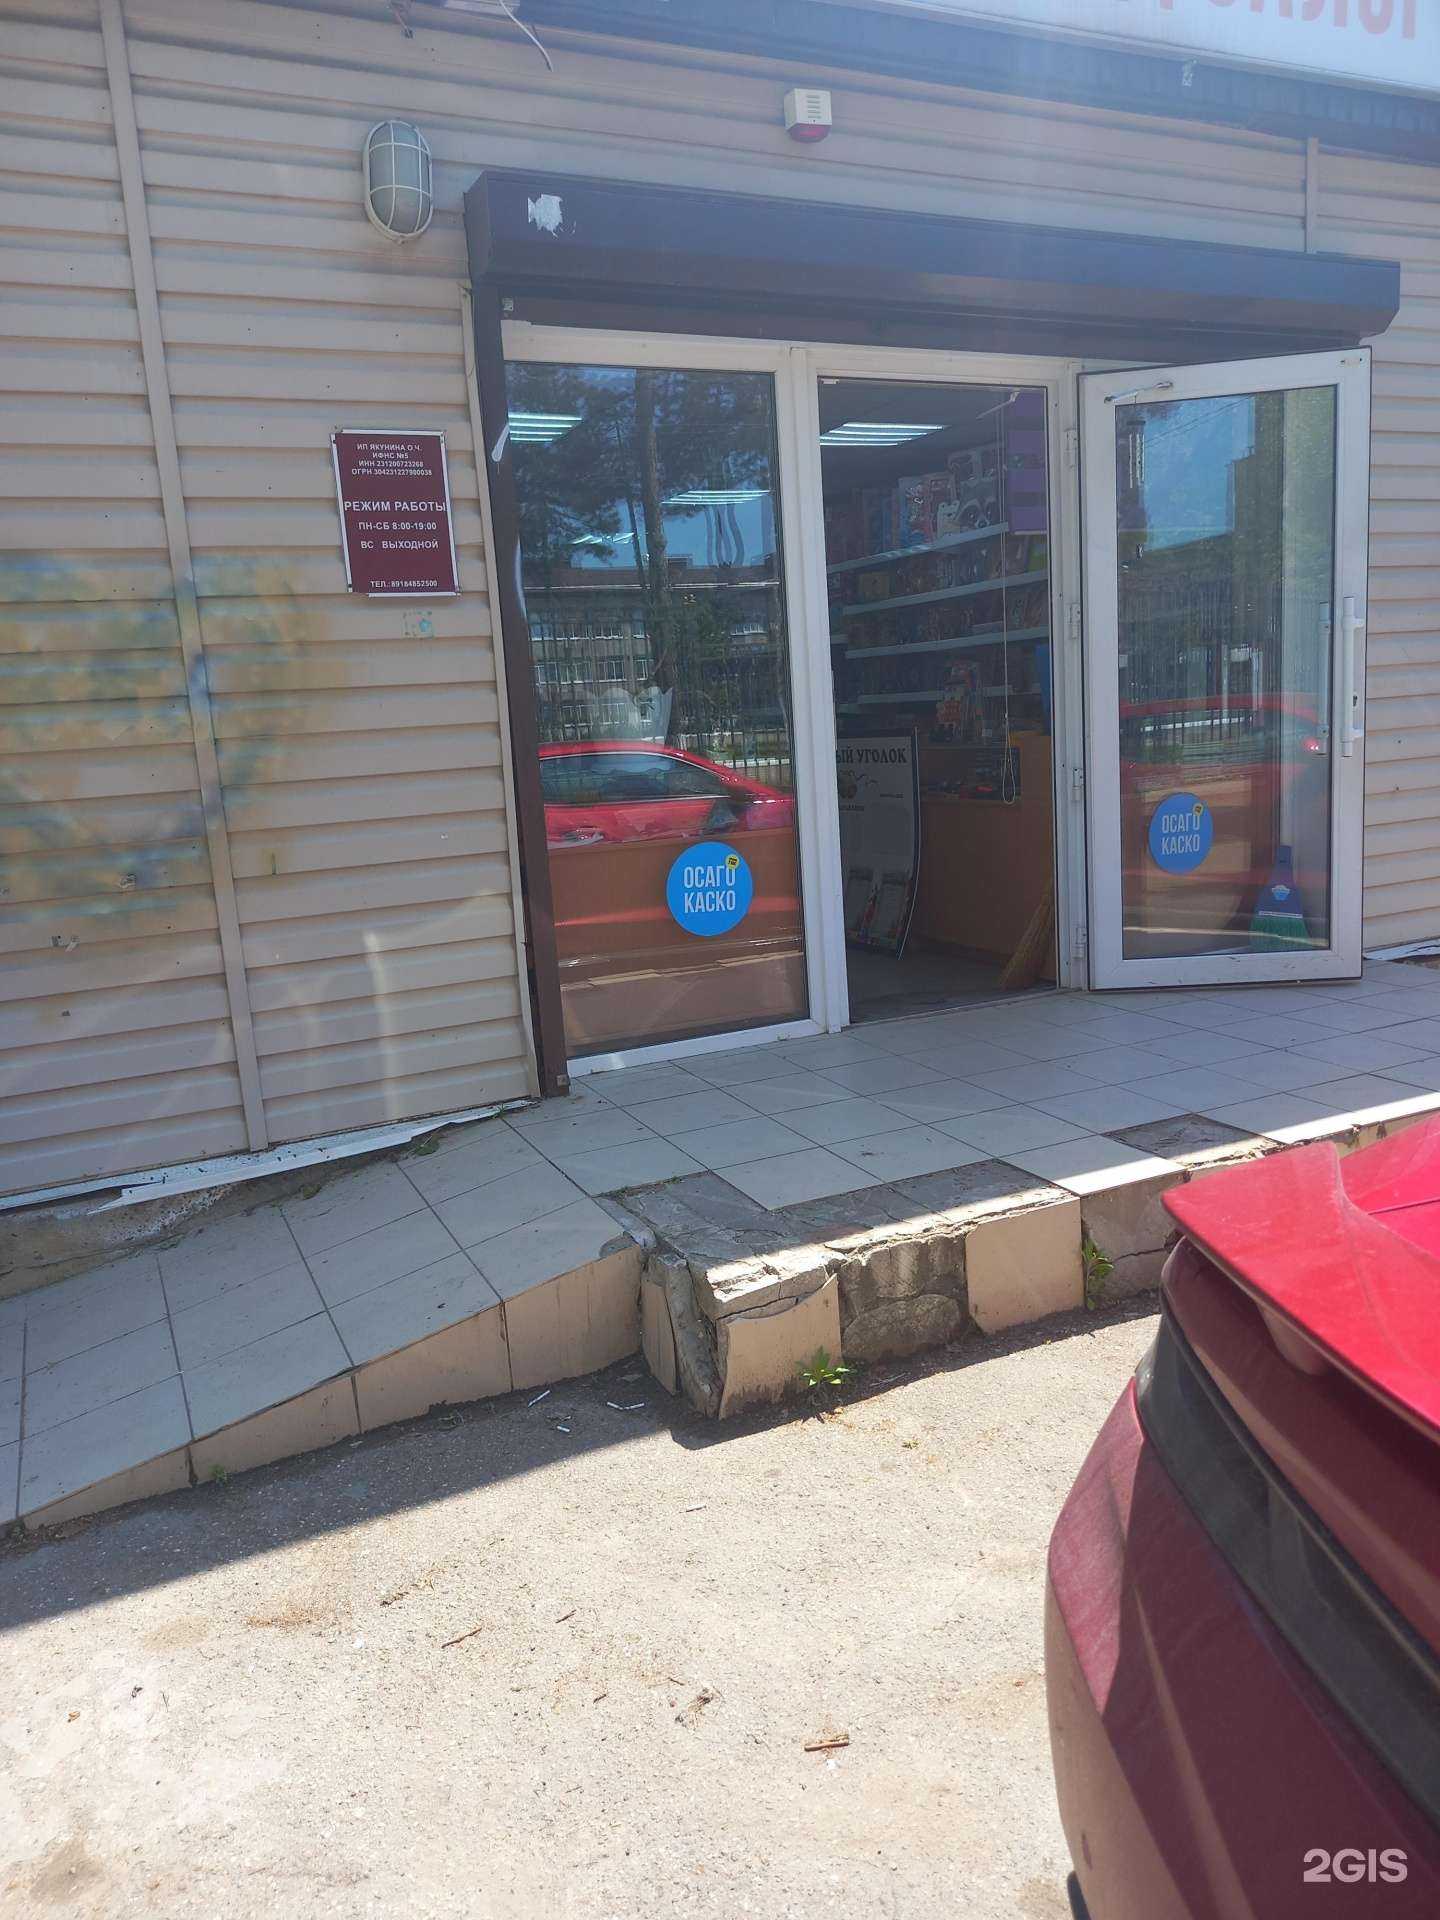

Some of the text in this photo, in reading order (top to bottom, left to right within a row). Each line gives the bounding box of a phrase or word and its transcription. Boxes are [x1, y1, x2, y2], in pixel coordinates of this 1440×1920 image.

[356, 443, 368, 451] ИП
[343, 501, 446, 512] РЕЖИМ РАБОТЫ
[358, 521, 437, 531] ПН-СБ 8:00-19:00
[360, 539, 439, 550] ВС ВЫХОДНОЙ
[856, 748, 907, 764] УГОЛОК
[1162, 813, 1200, 833] ОСАГО
[1162, 834, 1201, 855] КАСКО
[683, 865, 736, 889] ОСАГО
[684, 890, 736, 914] КАСКО
